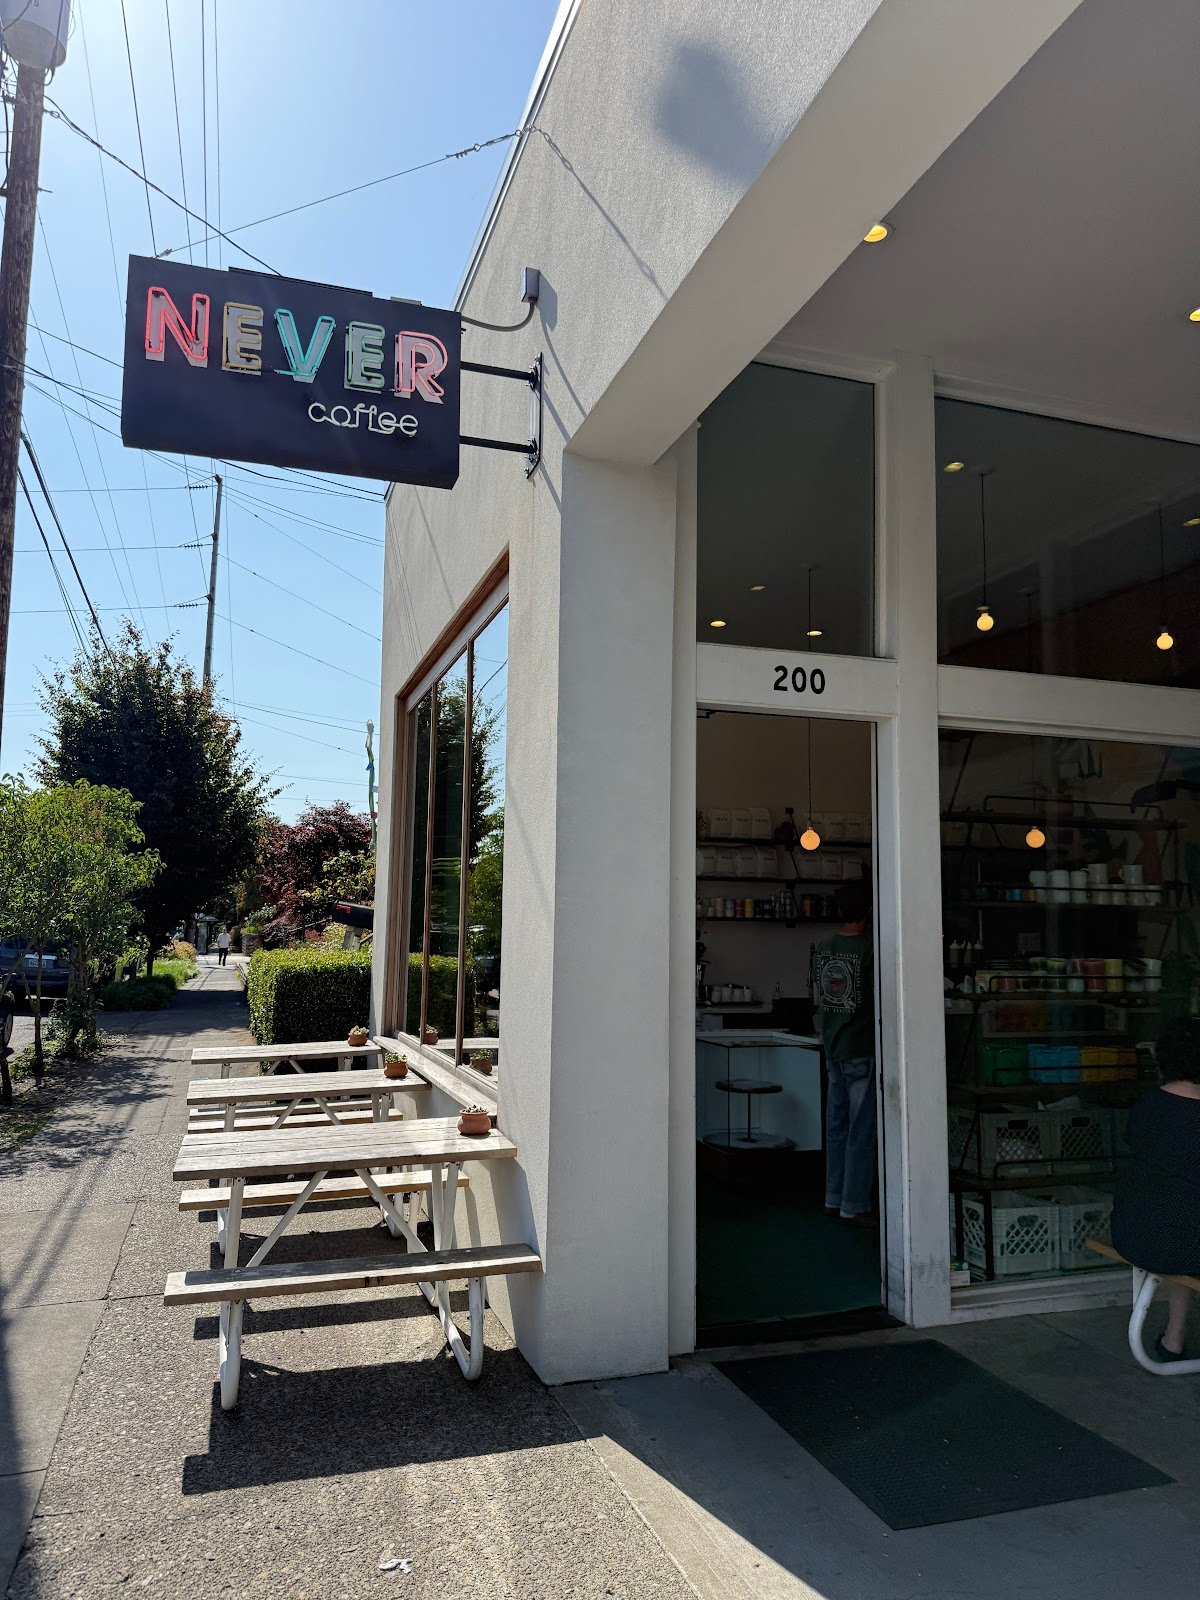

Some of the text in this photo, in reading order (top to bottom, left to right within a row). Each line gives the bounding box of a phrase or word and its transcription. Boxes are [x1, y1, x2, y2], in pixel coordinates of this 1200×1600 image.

[145, 286, 448, 404] NEVER
[308, 402, 418, 437] coffee
[773, 665, 826, 695] 200
